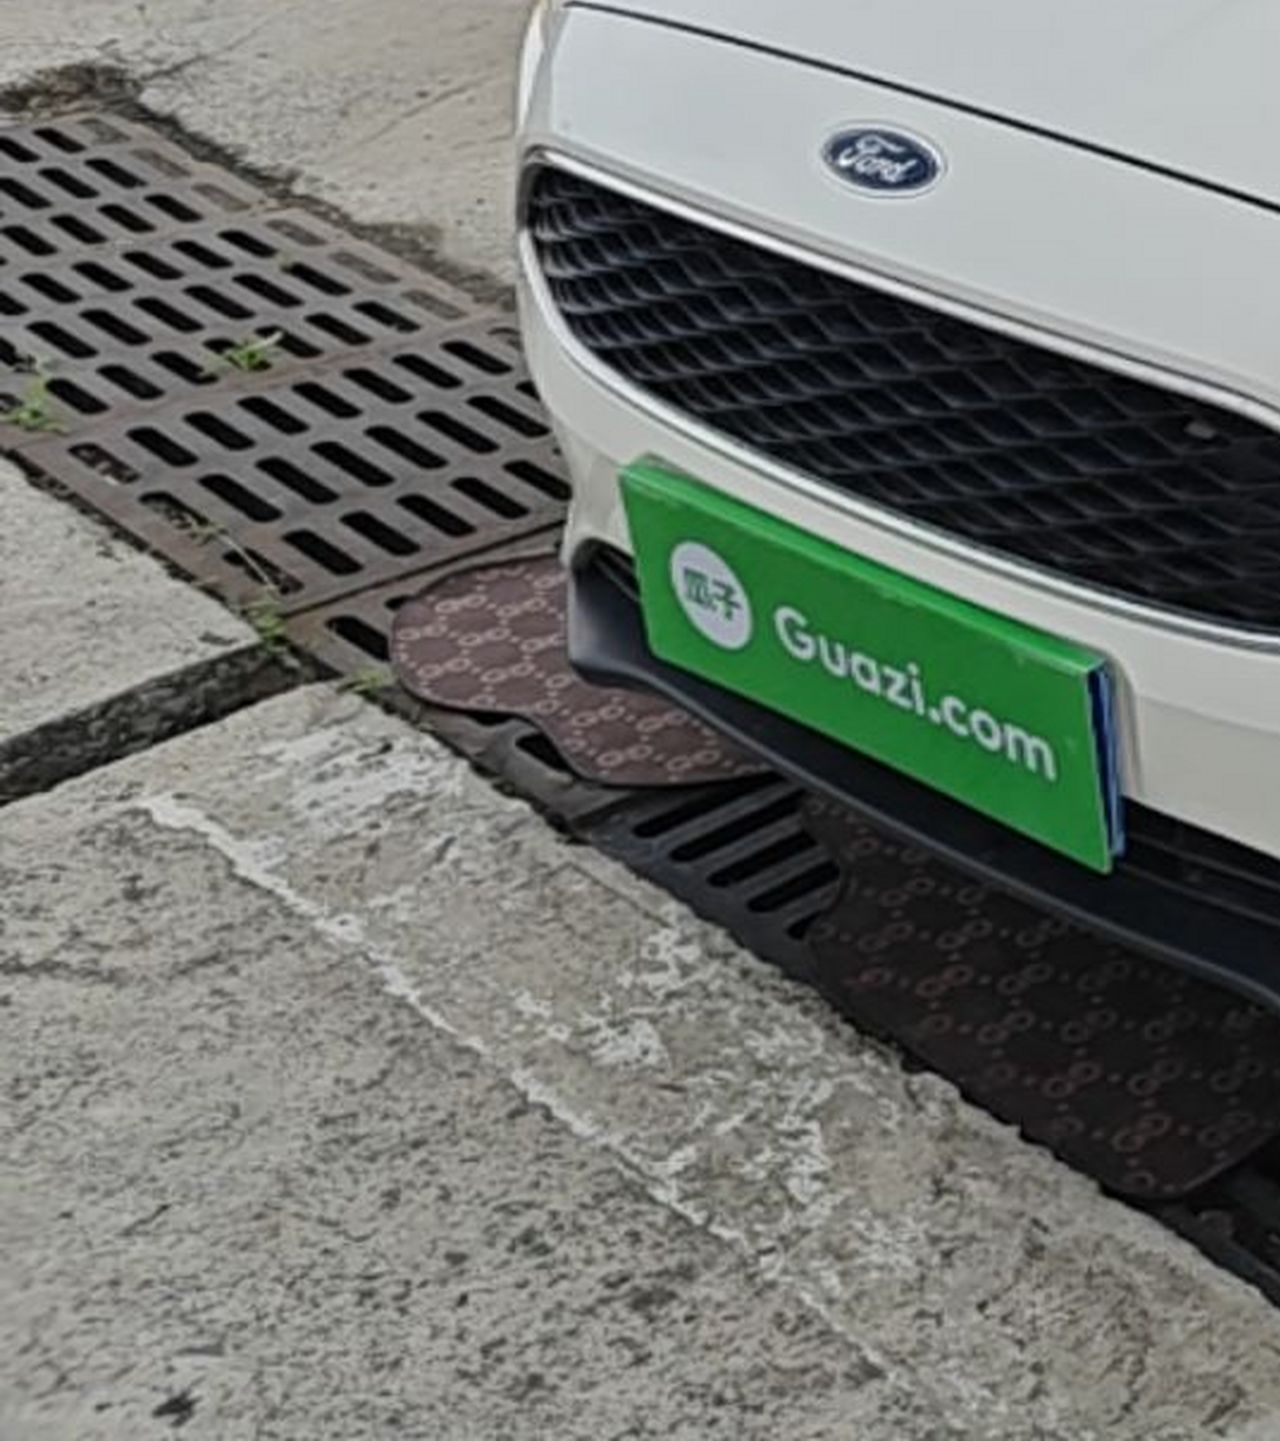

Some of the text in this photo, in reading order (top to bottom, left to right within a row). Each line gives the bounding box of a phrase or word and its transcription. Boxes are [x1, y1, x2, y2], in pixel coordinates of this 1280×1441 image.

[837, 132, 920, 184] Ford
[682, 565, 742, 621] 瓜子
[773, 605, 1058, 783] Guazi.com
